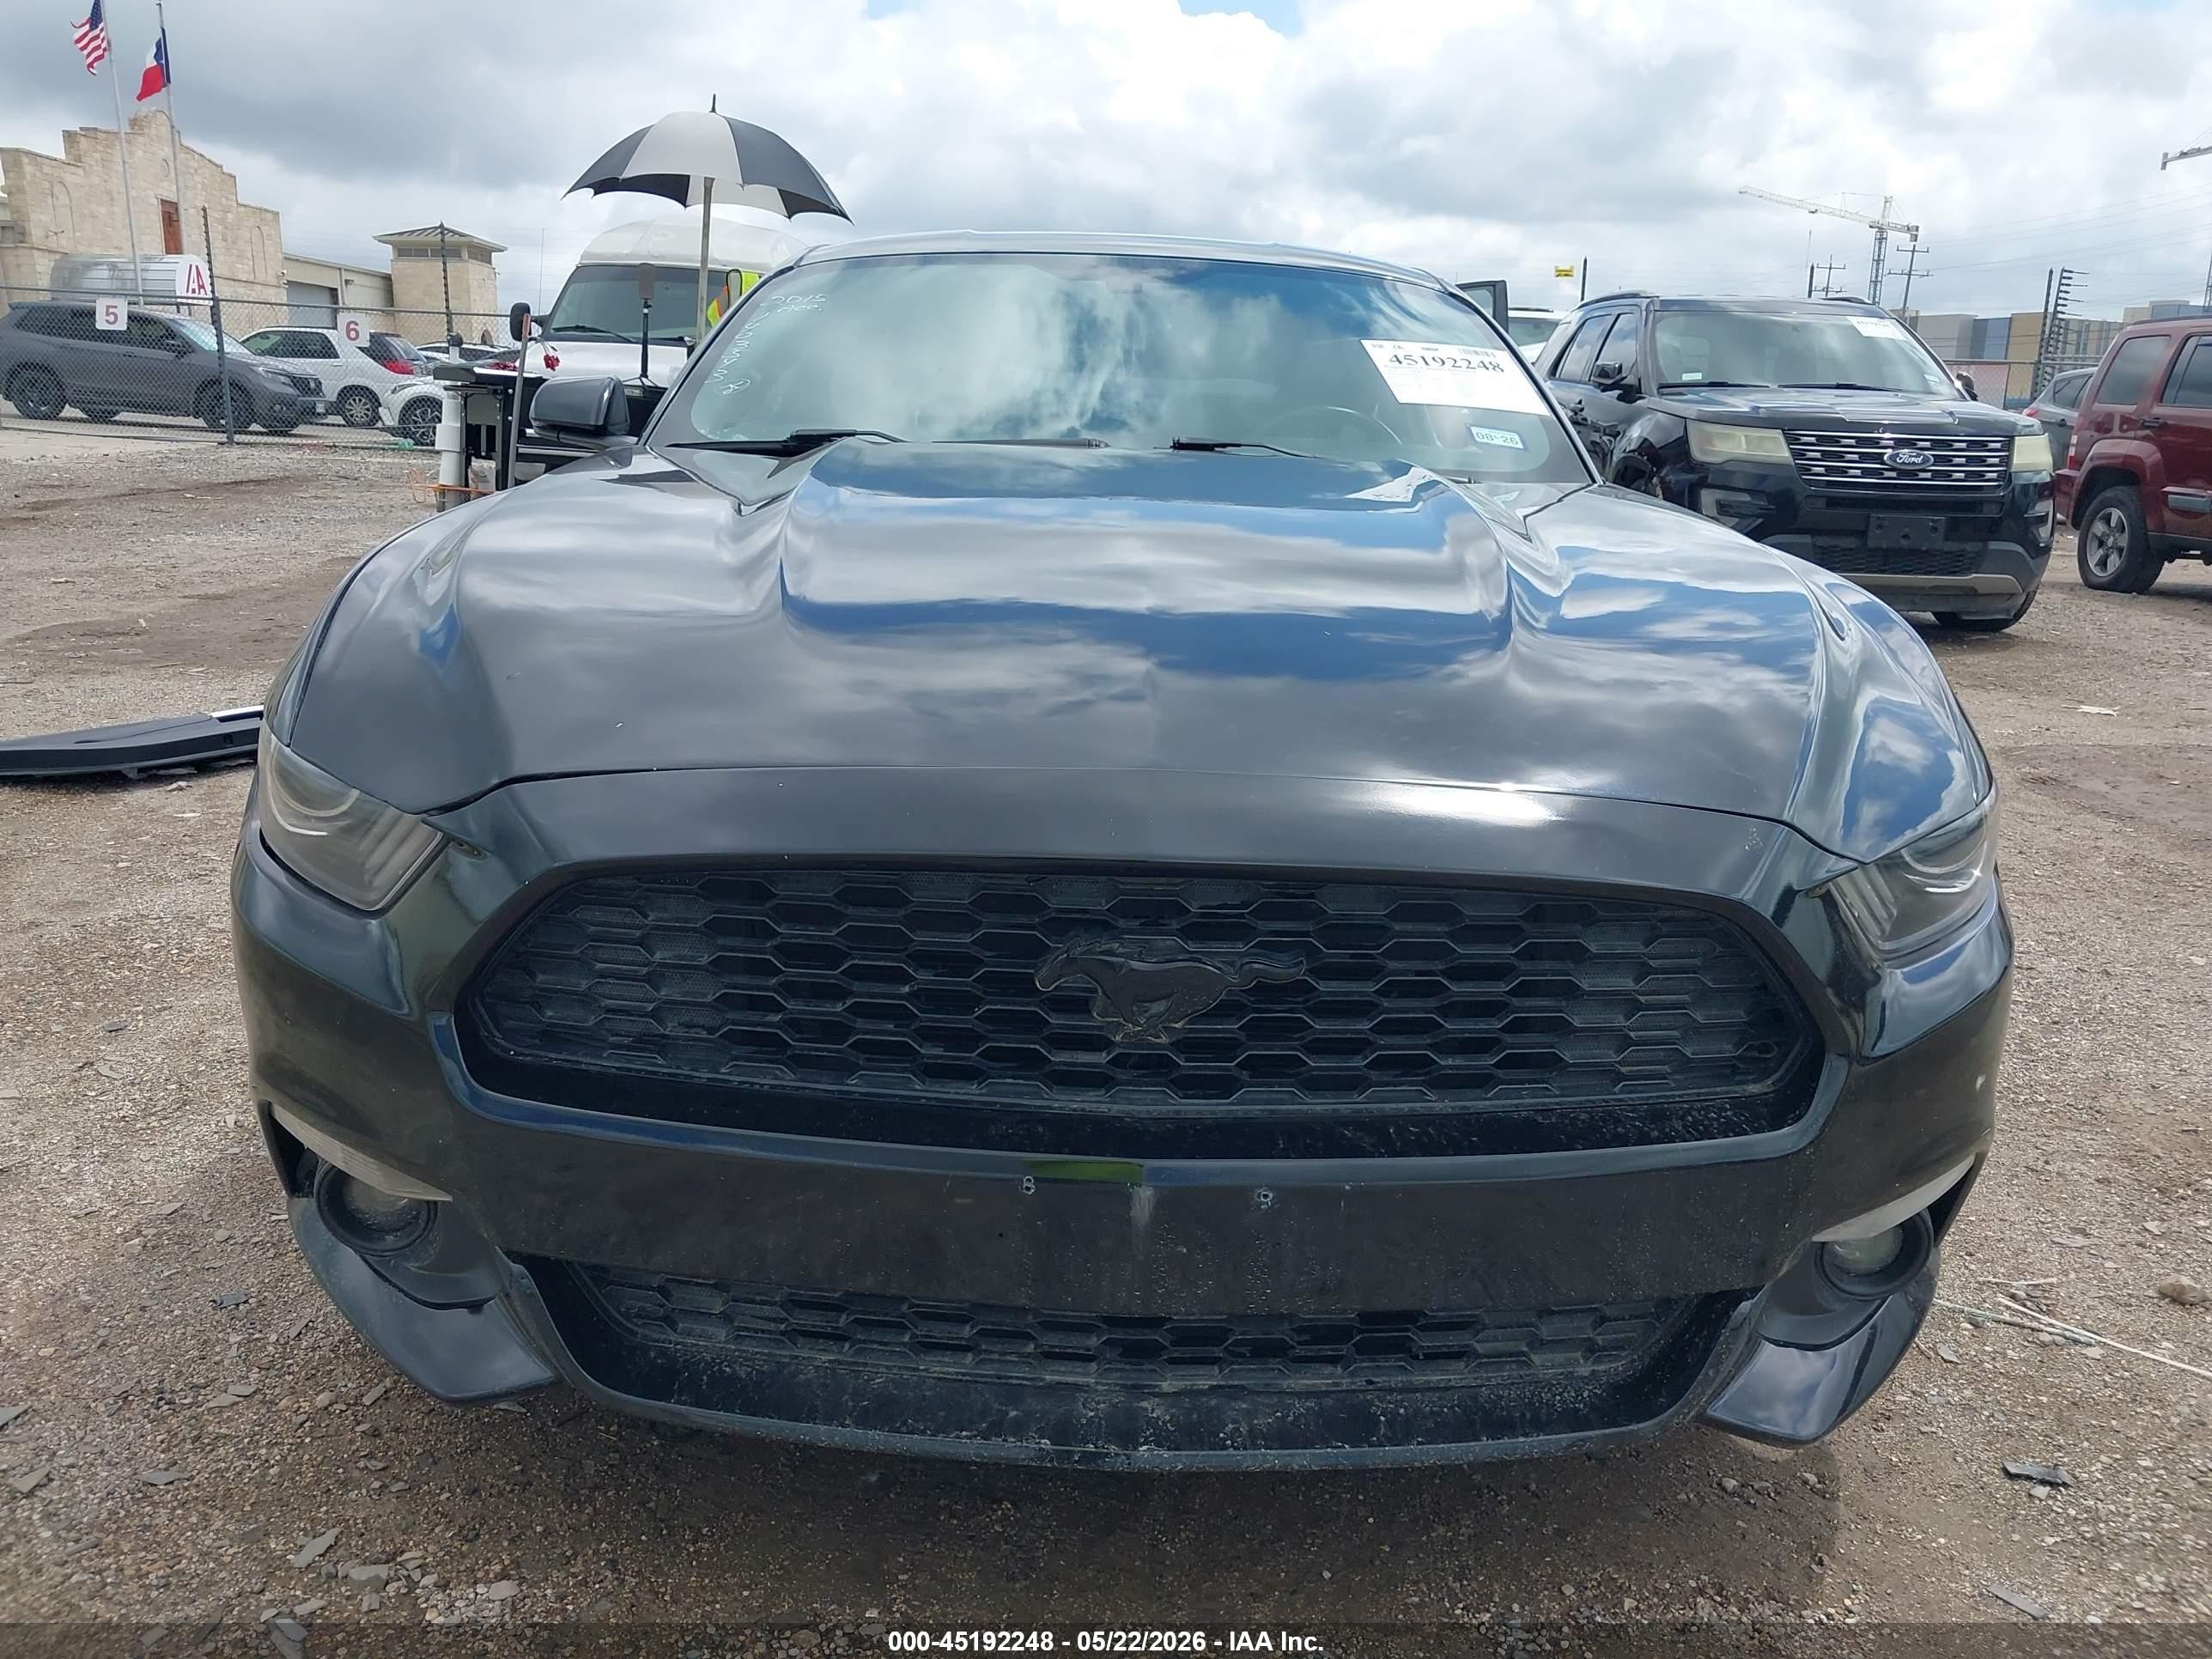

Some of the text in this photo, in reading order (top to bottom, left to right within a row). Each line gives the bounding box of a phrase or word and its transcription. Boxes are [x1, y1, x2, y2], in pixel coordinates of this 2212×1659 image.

[105, 304, 118, 325] 5
[346, 320, 360, 341] 6
[1389, 354, 1504, 373] 45192248
[1895, 451, 1923, 464] Ford
